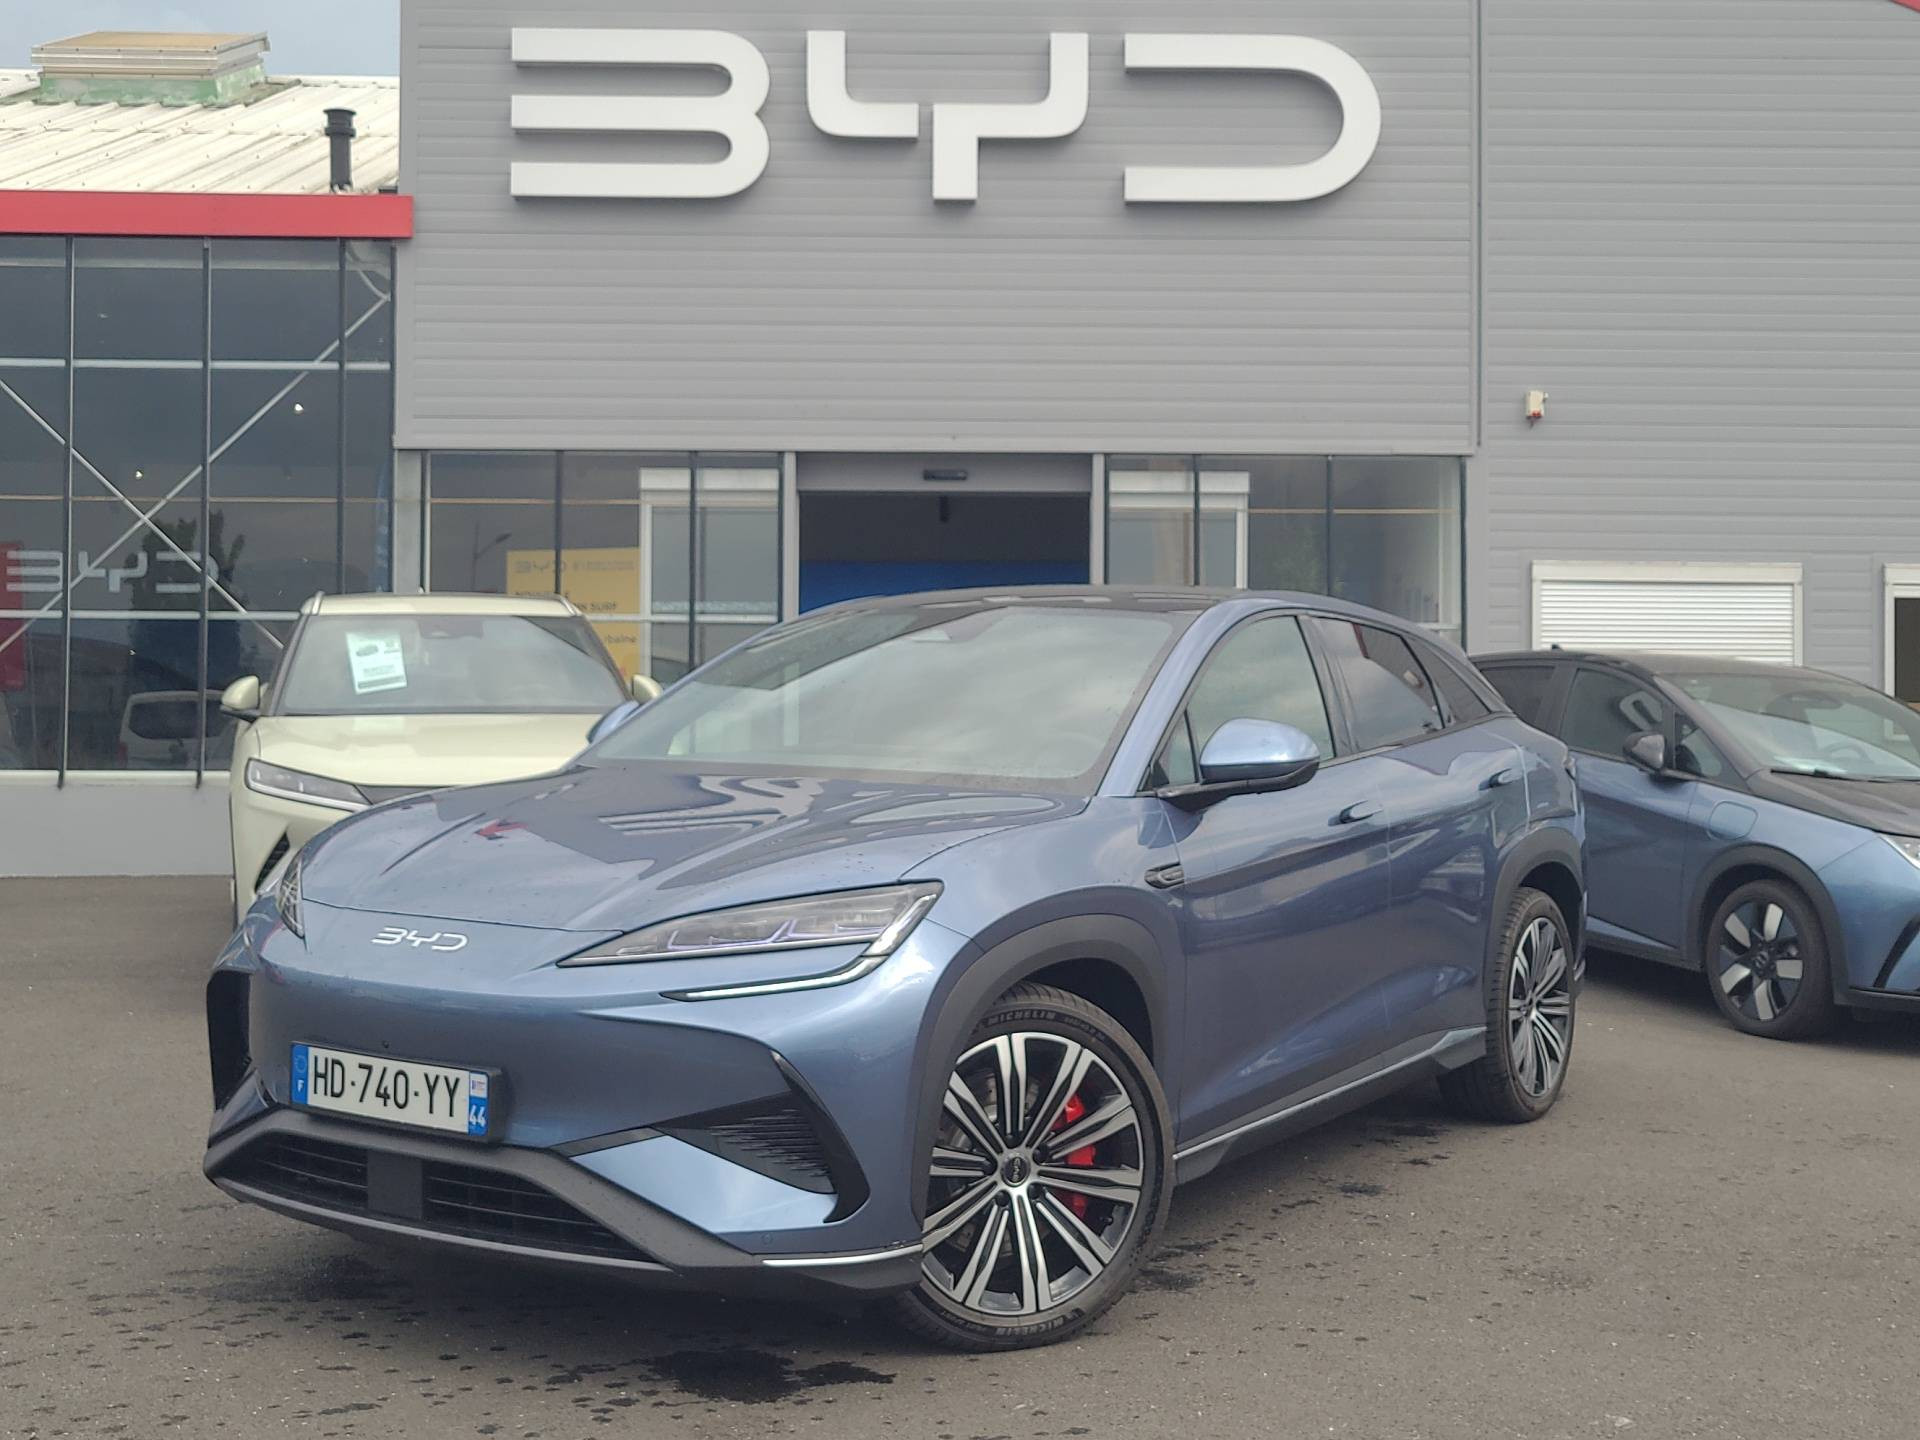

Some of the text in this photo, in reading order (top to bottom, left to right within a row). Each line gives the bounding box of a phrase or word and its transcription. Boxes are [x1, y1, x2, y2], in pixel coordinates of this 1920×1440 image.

[511, 27, 1382, 201] BYD
[6, 550, 219, 593] BYD
[371, 927, 468, 951] BYD
[987, 1009, 1057, 1026] MICHELIN
[297, 1079, 305, 1092] F
[470, 1104, 487, 1127] 44
